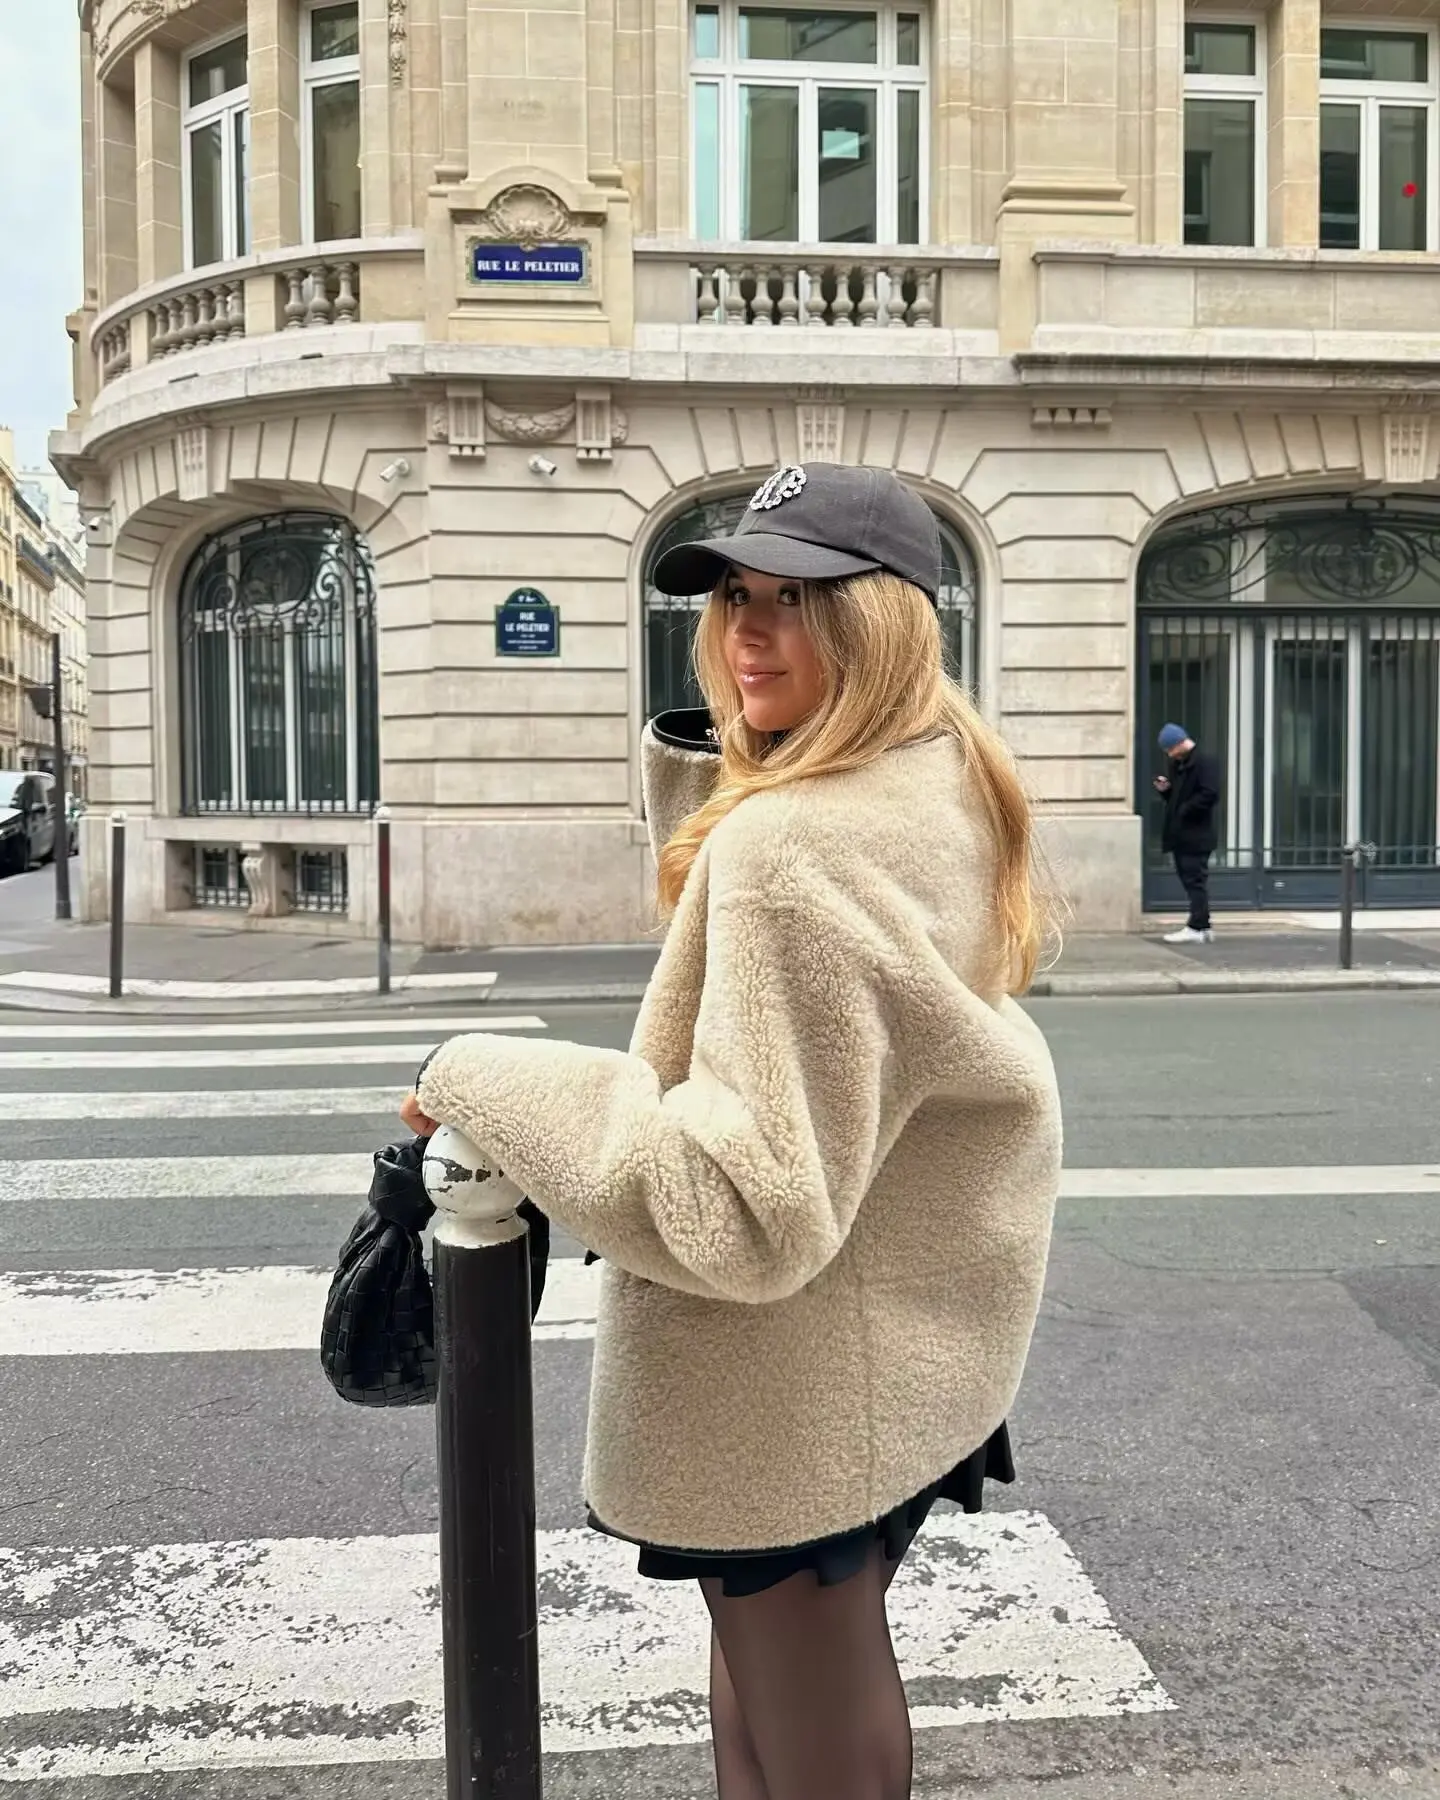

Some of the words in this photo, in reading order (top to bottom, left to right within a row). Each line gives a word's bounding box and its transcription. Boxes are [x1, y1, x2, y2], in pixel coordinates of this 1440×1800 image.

[477, 260, 501, 271] RUE
[505, 260, 521, 272] LE
[524, 261, 579, 273] PELETIER
[519, 612, 536, 621] RUE
[504, 623, 515, 632] LE
[516, 623, 550, 632] PELETIER
